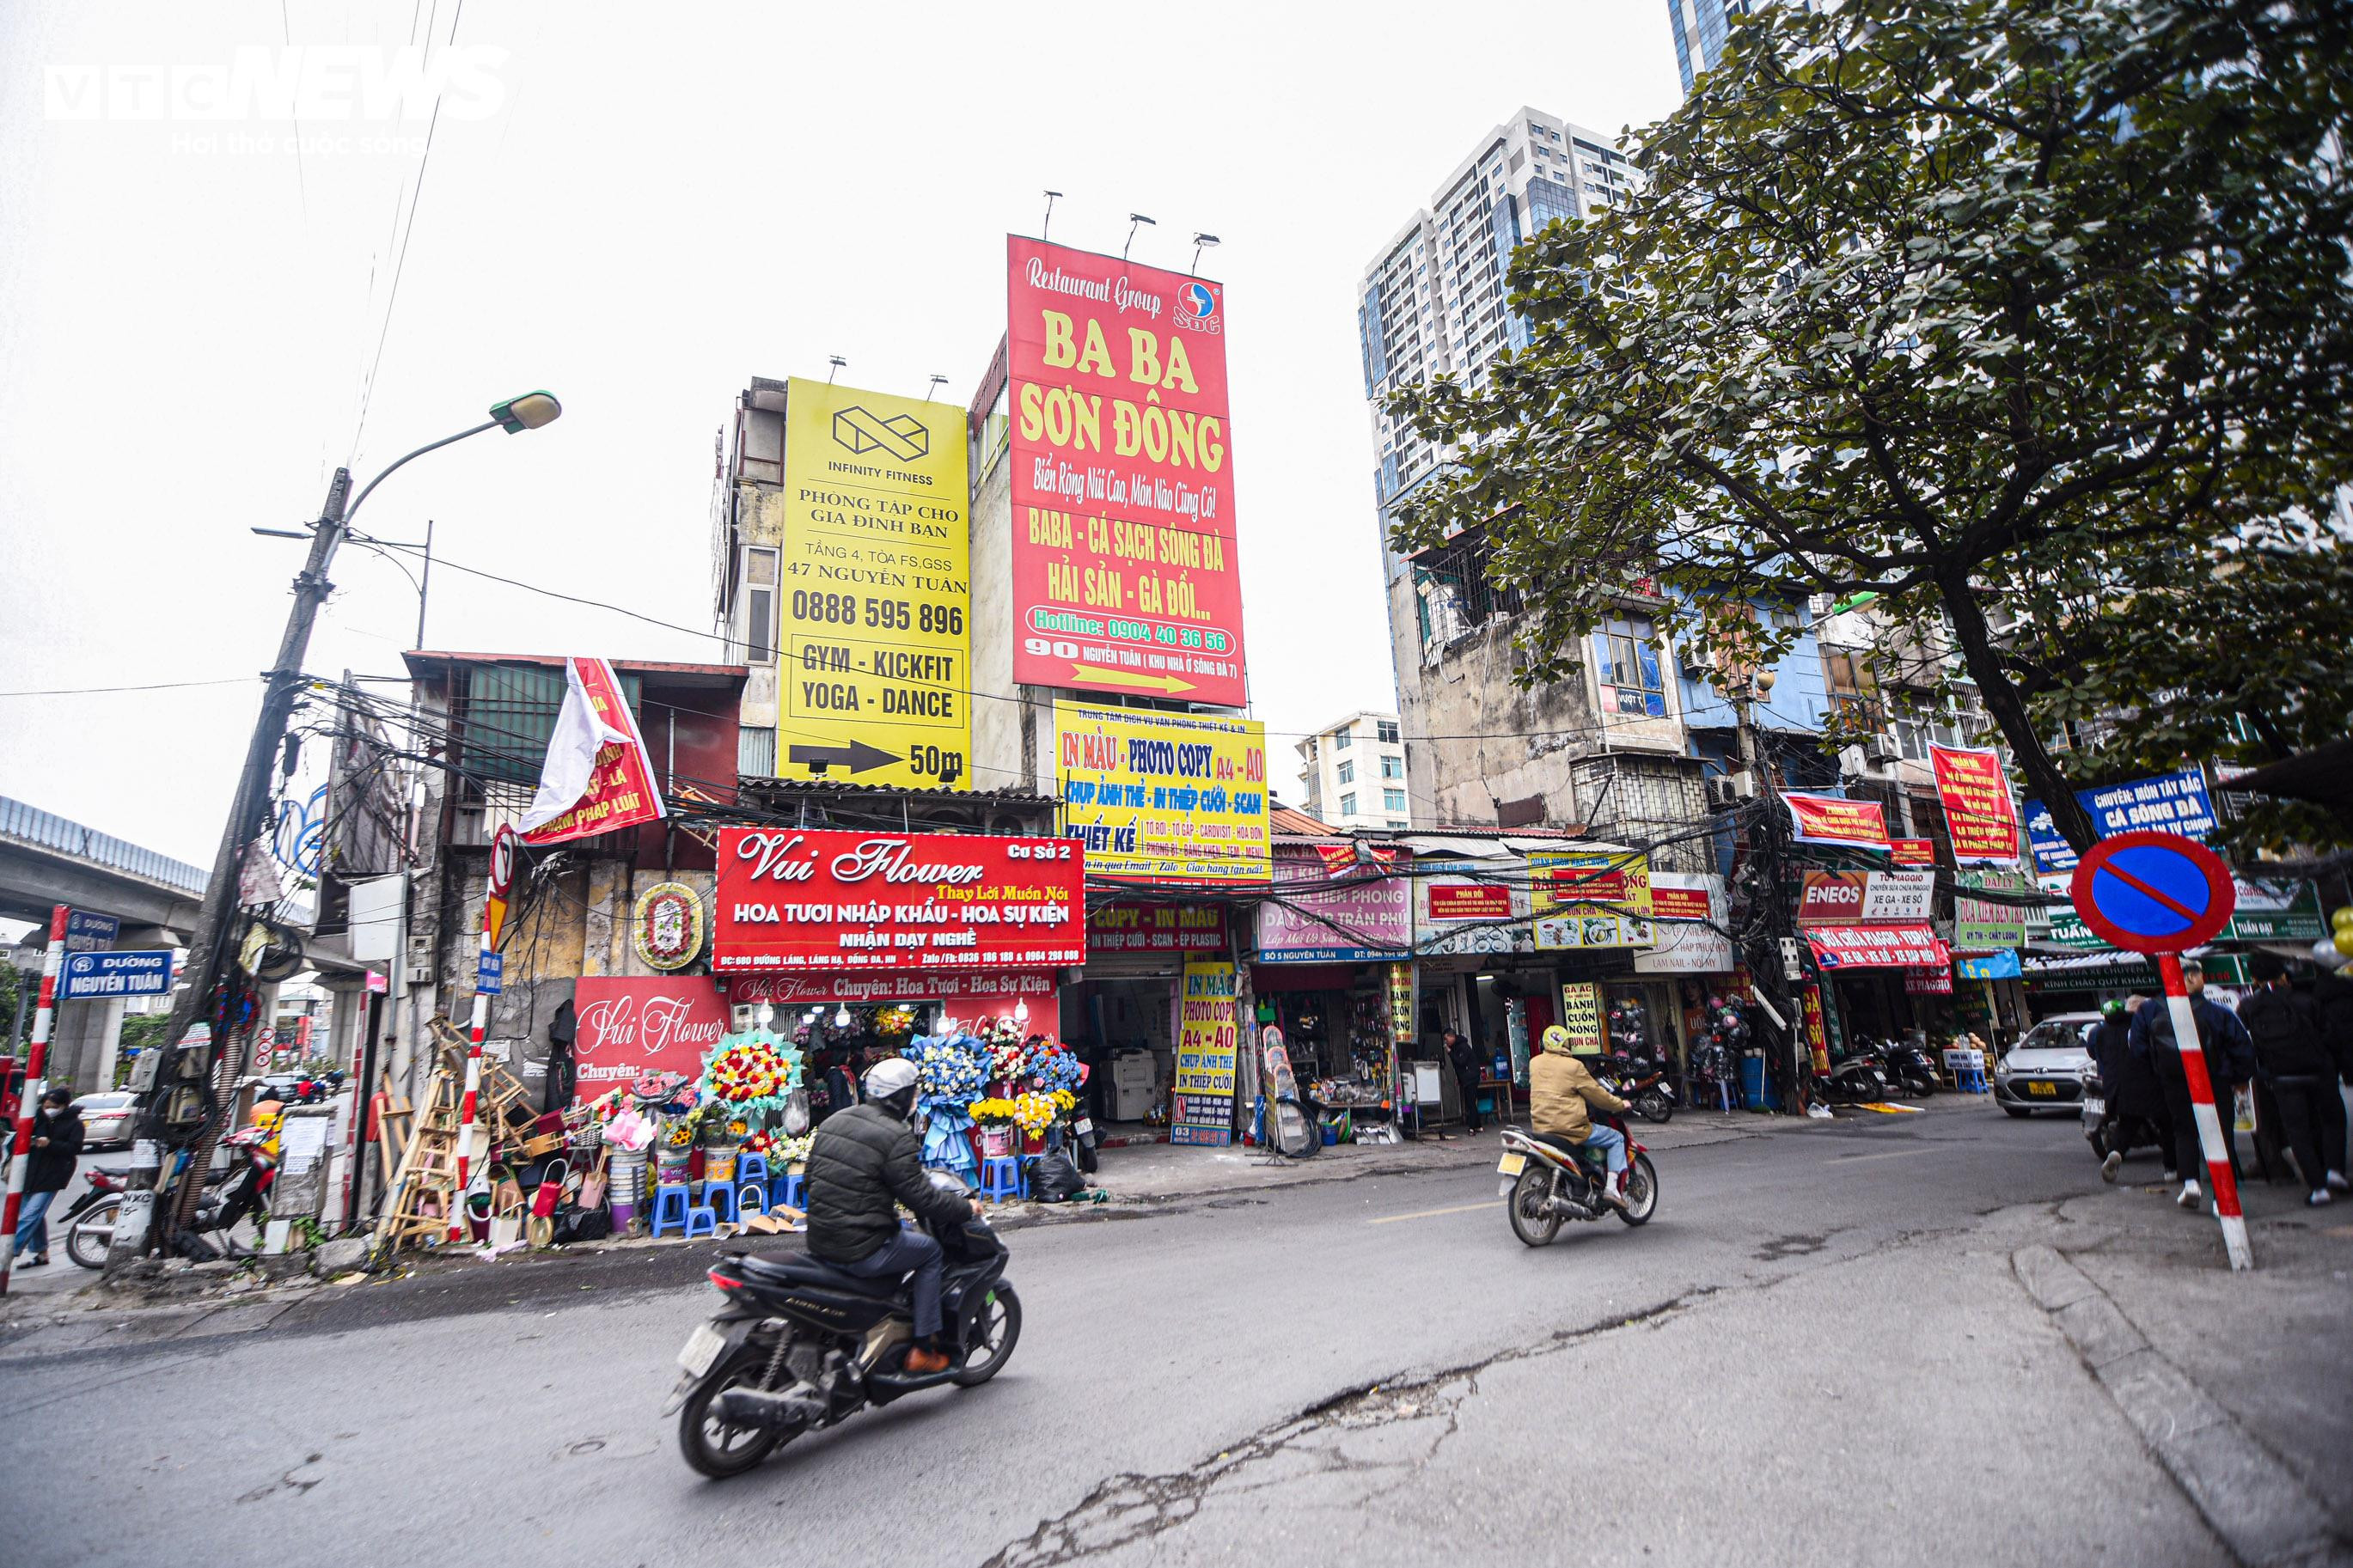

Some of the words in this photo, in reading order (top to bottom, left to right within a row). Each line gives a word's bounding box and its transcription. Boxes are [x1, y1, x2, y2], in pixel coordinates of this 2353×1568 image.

[1026, 257, 1110, 302] Restaurant
[1115, 277, 1162, 320] Group
[1042, 309, 1115, 378] BA
[1128, 327, 1198, 394] BA
[1019, 381, 1102, 453] SƠN
[1113, 388, 1224, 473] ĐÔNG
[828, 461, 882, 479] INFINITY
[886, 470, 933, 486] FITNESS
[1033, 453, 1056, 491] Biển
[1059, 465, 1084, 504] Rộng
[1087, 467, 1104, 494] Núi
[1132, 473, 1152, 508] Món
[1155, 476, 1173, 512] Nào
[1176, 482, 1200, 522] Cũng
[799, 489, 871, 510] PHÒNG
[877, 500, 913, 517] TẬP
[918, 506, 959, 522] CHO
[810, 509, 846, 526] GIA
[853, 513, 904, 533] ĐÌNH
[911, 522, 948, 540] BẠN
[1028, 507, 1073, 550] BABA
[1088, 511, 1110, 555] CÁ
[1114, 520, 1155, 566] SẠCH
[1159, 522, 1200, 570] SÔNG
[1203, 529, 1224, 571] ĐÀ
[805, 540, 846, 558] TẦNG
[868, 550, 896, 565] TÒA
[787, 562, 811, 576] 47
[1048, 555, 1079, 603] HẢI
[1085, 560, 1122, 608] SẢN
[1139, 570, 1164, 615] GÀ
[792, 589, 856, 625] 0888
[865, 597, 910, 631] 595
[919, 603, 963, 636] 896
[1035, 610, 1103, 636] Hotline:
[1109, 619, 1151, 641] 0904
[1155, 627, 1176, 644] 40
[1181, 629, 1201, 648] 36
[1205, 632, 1225, 650] 56
[803, 644, 851, 673] GYM
[874, 650, 953, 681] KICKFIT
[1024, 638, 1079, 659] 90
[1167, 655, 1184, 672] NHÀ
[1194, 658, 1215, 675] SÔNG
[802, 681, 859, 711] YOGA
[883, 687, 953, 717] DANCE
[1079, 709, 1103, 720] TRUNG
[910, 745, 963, 776] 50m
[1062, 732, 1079, 767] IN
[1128, 739, 1175, 775] PHOTO
[1177, 742, 1213, 778] COPY
[1216, 757, 1233, 780] A4
[610, 766, 627, 786] LÀ
[1097, 775, 1122, 806] ẢNH
[1125, 778, 1146, 808] THẺ
[1154, 787, 1167, 809] IN
[1169, 784, 1198, 816] THIỆP
[1201, 784, 1226, 813] CƯỚI
[1234, 793, 1262, 815] SCAN
[2094, 789, 2135, 809] CHUYÊN:
[2134, 783, 2159, 802] MÓN
[2159, 779, 2179, 797] TÂY
[2179, 772, 2202, 795] BẮC
[577, 797, 610, 825] PHÁP
[614, 790, 641, 813] LUẬT
[2105, 808, 2128, 828] CÁ
[2128, 801, 2174, 825] SÔNG
[2175, 795, 2203, 817] ĐÀ
[1114, 816, 1137, 852] KẾ
[1200, 824, 1231, 839] CARDVISIT
[737, 833, 819, 882] Vui
[830, 839, 984, 885] Flower
[1007, 844, 1031, 859] Cơ
[1033, 840, 1056, 860] Sở
[1245, 846, 1264, 859] MENU
[1125, 861, 1152, 871] Email
[1158, 862, 1178, 871] Zalo
[1186, 862, 1206, 873] Giao
[936, 885, 975, 903] Thay
[975, 886, 999, 900] Lời
[1003, 885, 1042, 900] Muốn
[1352, 891, 1403, 903] PHONG
[1456, 889, 1472, 899] PHẢN
[1806, 886, 1860, 904] ENEOS
[1873, 895, 1884, 904] XE
[1885, 895, 1896, 904] GA
[1901, 895, 1910, 904] XE
[1912, 893, 1922, 904] SỐ
[734, 903, 780, 924] HOA
[785, 904, 833, 924] TƯƠI
[837, 900, 889, 928] NHẬP
[894, 896, 948, 924] KHẨU
[961, 904, 1001, 924] HOA
[1004, 904, 1029, 928] SỰ
[1030, 900, 1069, 929] KIỆN
[1095, 907, 1140, 928] COPY
[1155, 909, 1176, 927] IN
[1152, 934, 1173, 946] SCAN
[1191, 934, 1221, 946] PLASTIC
[1863, 930, 1899, 946] PIAGGIO
[1899, 930, 1928, 946] VESPA
[103, 955, 162, 968] ĐƯỜNG
[809, 955, 829, 965] LÁNG
[1839, 950, 1853, 963] XE
[1854, 951, 1866, 963] GA
[1867, 950, 1879, 963] XE
[1879, 947, 1892, 962] SỐ
[1895, 950, 1906, 962] XE
[70, 973, 125, 993] NGUYỄN
[128, 970, 163, 991] TUÂN
[738, 978, 773, 1001] Vui
[777, 977, 829, 1001] Flower
[834, 978, 893, 999] Chuyên:
[895, 977, 924, 995] Hoa
[927, 976, 960, 994] Tươi
[970, 976, 997, 993] Hoa
[1020, 975, 1050, 996] Kiện
[1188, 975, 1202, 996] IN
[1565, 985, 1576, 993] GÀ
[1580, 984, 1592, 992] ÁC
[1924, 979, 1950, 991] PIAGGIO
[1184, 1000, 1212, 1022] PHOTO
[1213, 1000, 1237, 1022] COPY
[1566, 998, 1594, 1010] BÁNH
[575, 995, 637, 1055] Vui
[641, 996, 727, 1056] Flower
[1568, 1010, 1595, 1022] CUỐN
[1183, 1029, 1201, 1046] A4
[1568, 1023, 1597, 1034] NÓNG
[577, 1063, 640, 1082] Chuyên:
[1180, 1054, 1199, 1073] CHỤP
[1202, 1050, 1217, 1069] ẢNH
[1189, 1071, 1212, 1091] THIỆP
[1213, 1074, 1232, 1090] CƯỚI
